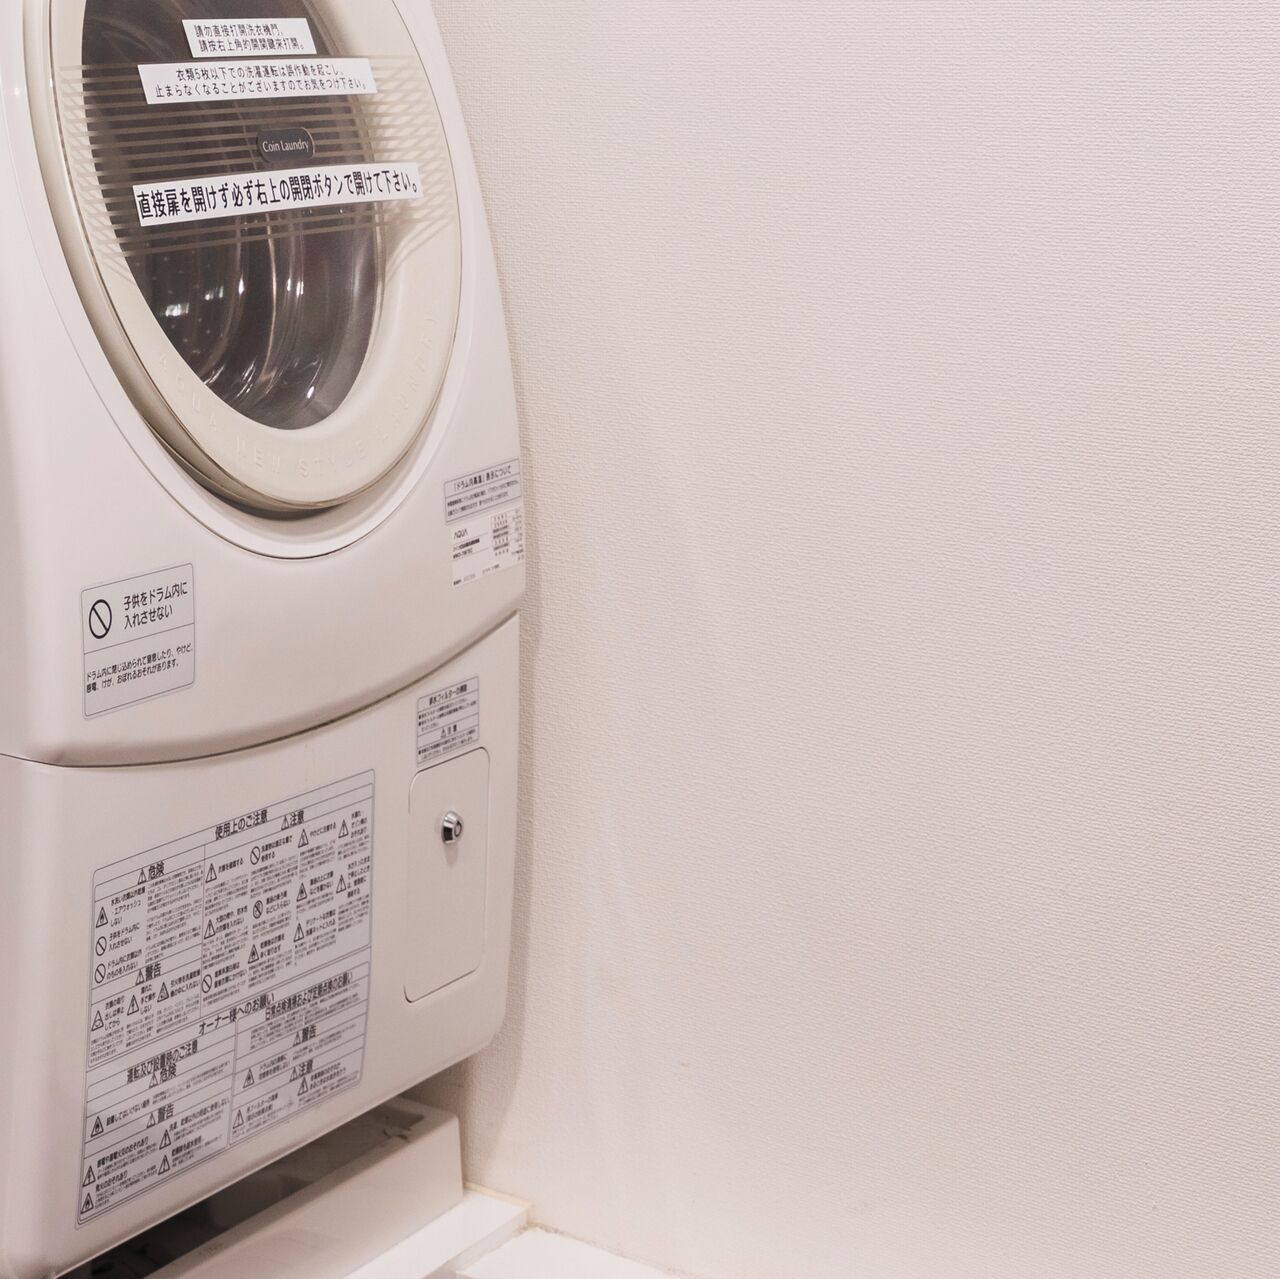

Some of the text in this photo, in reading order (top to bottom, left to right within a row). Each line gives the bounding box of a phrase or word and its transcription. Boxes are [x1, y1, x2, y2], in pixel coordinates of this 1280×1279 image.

[262, 136, 310, 153] Coin Laundry
[137, 169, 418, 219] 直接扉を開けず必ず右上の開閉ボタンで開けて下さい。
[123, 582, 188, 611] 子供をドラム内に
[124, 605, 172, 629] 入れさせない
[215, 809, 268, 841] 使用上のご注意
